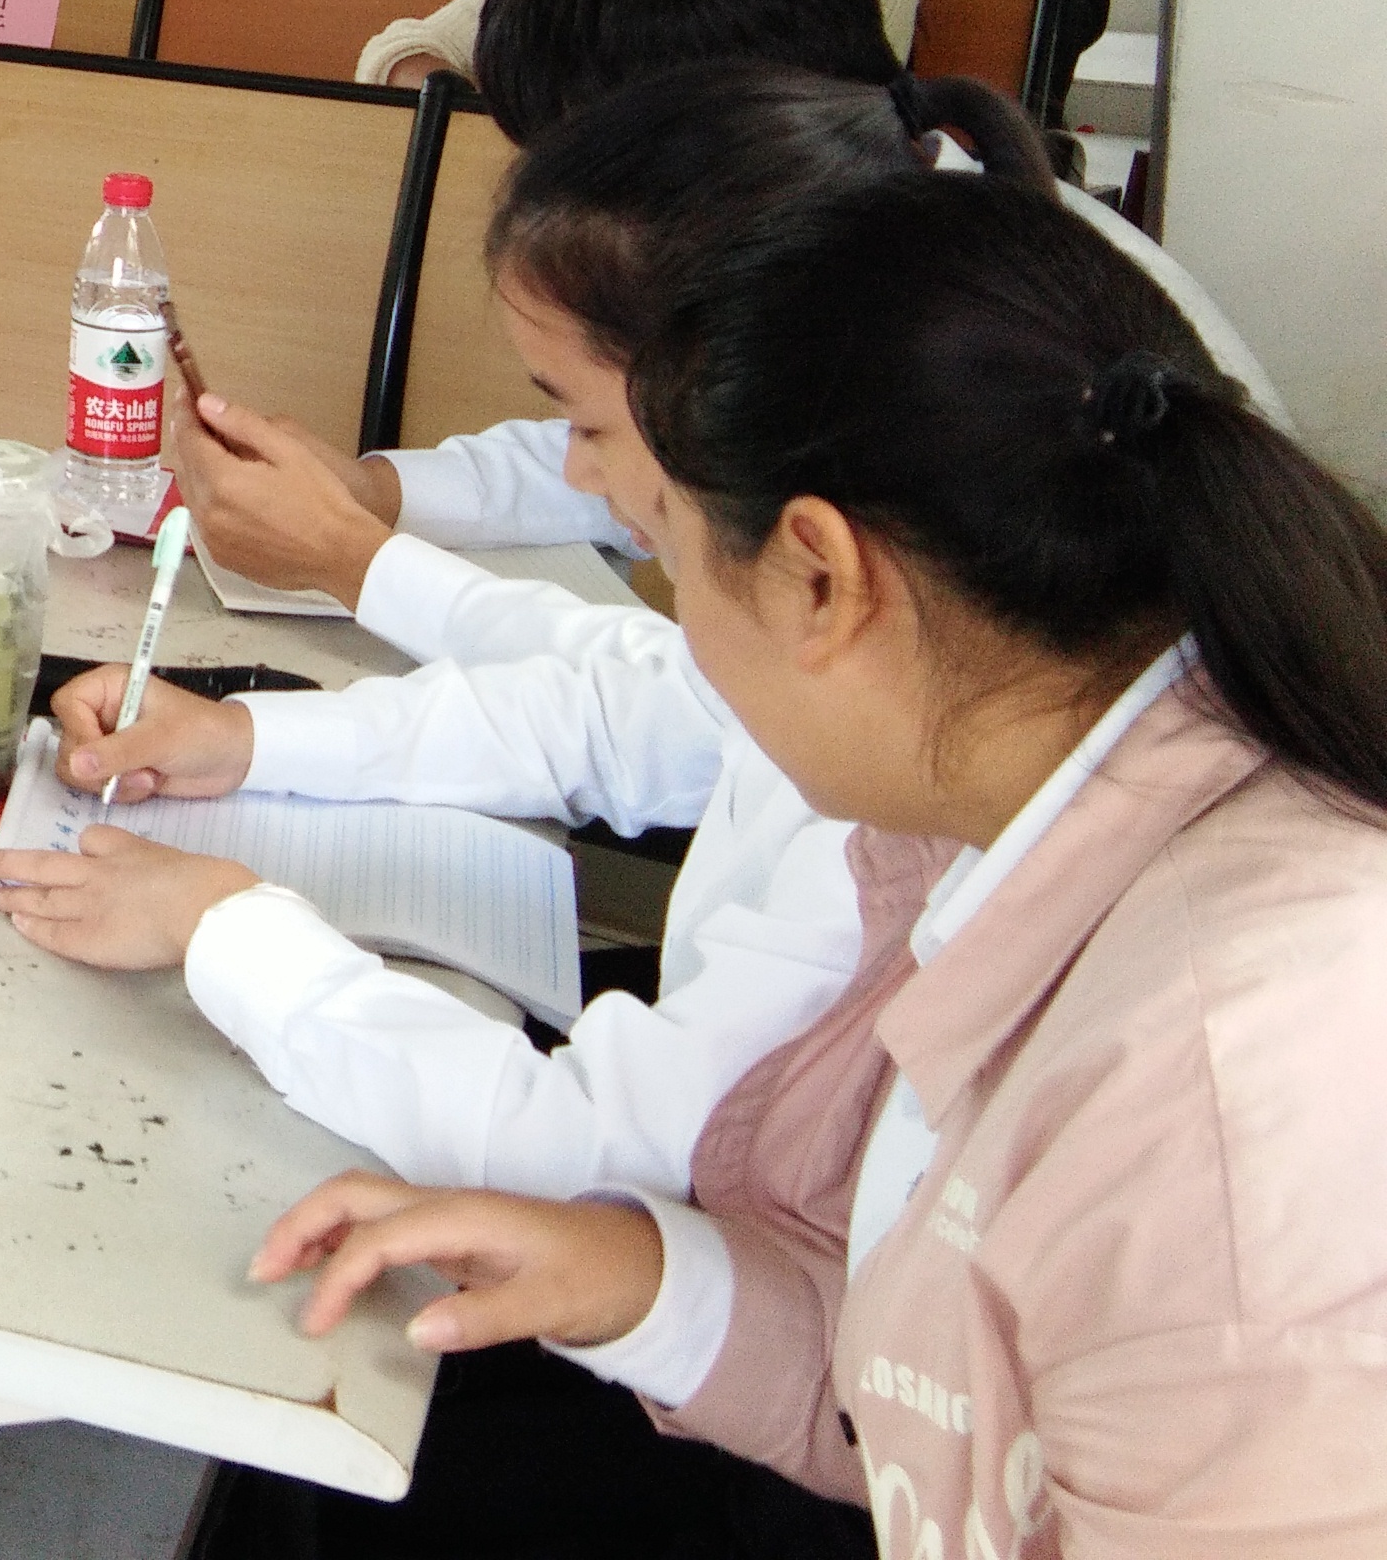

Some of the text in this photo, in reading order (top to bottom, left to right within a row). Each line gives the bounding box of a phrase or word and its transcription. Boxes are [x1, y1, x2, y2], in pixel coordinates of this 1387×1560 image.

[85, 395, 158, 421] 农夫山泉
[84, 417, 124, 433] NONGFU
